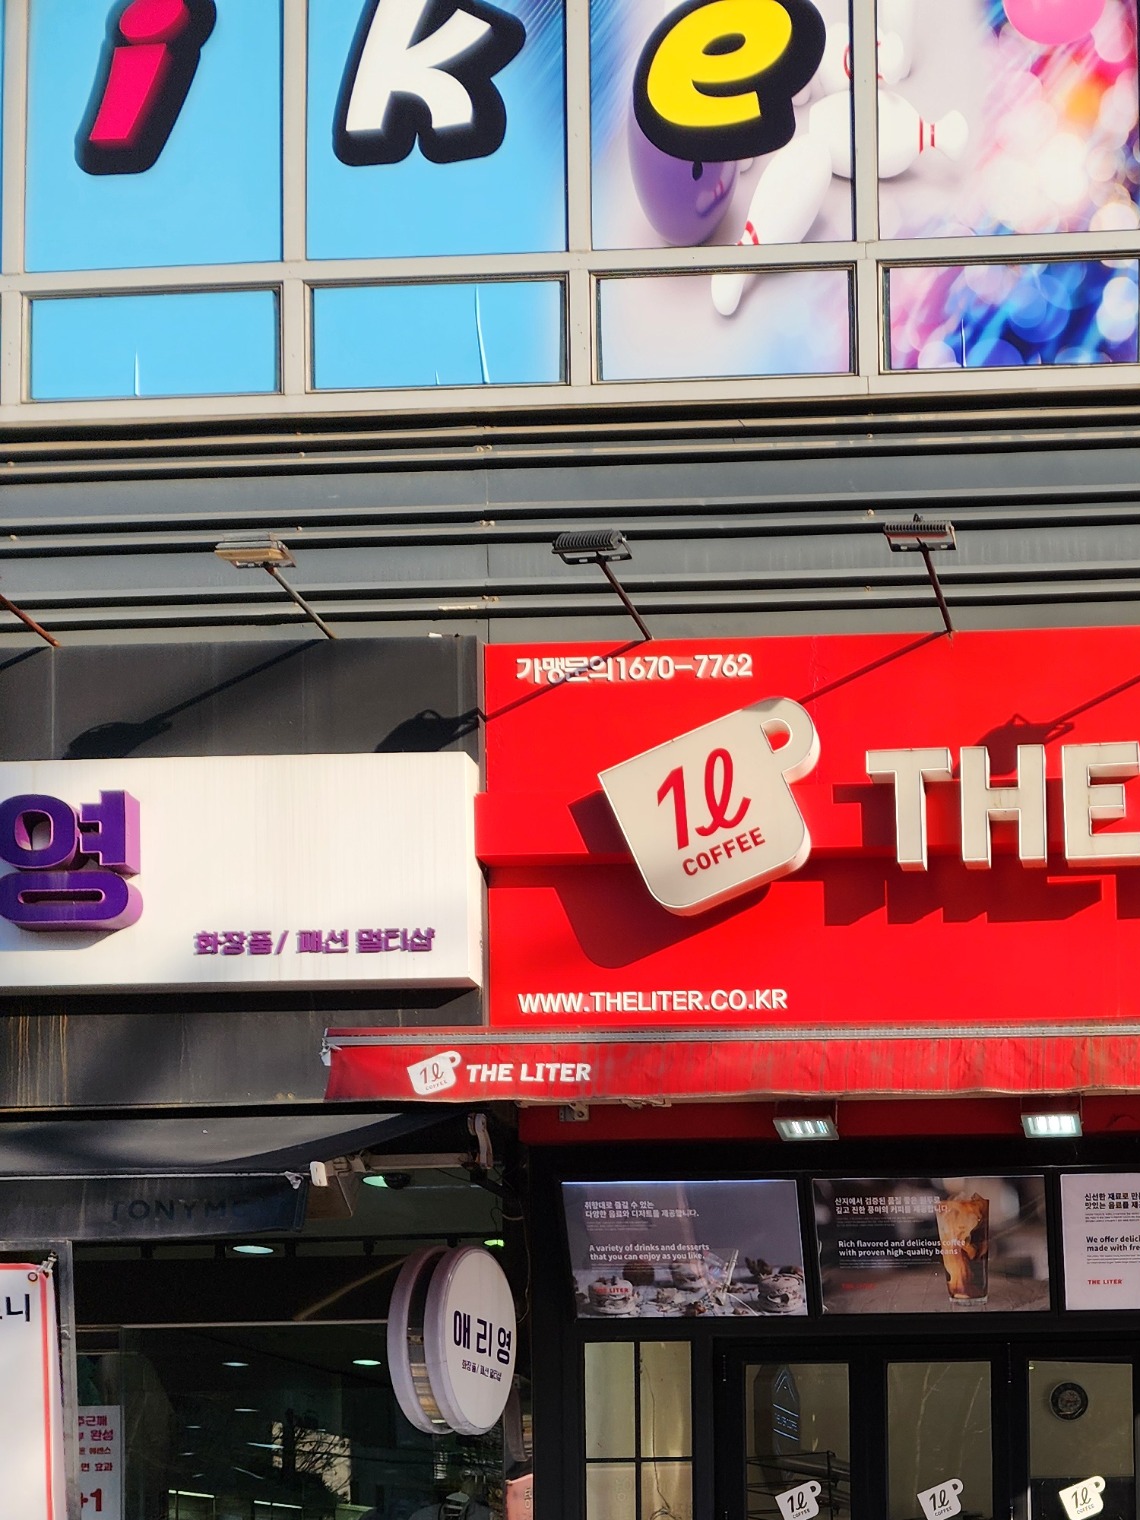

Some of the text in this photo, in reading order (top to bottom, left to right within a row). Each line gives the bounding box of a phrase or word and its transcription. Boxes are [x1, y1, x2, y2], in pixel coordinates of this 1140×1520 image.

[682, 827, 766, 876] COFFEE
[296, 930, 349, 954] 패션
[518, 988, 788, 1014] WWW.THELITER.CO.KR
[467, 1063, 591, 1083] THE LITER
[1084, 1192, 1106, 1201] 신선한
[838, 1238, 966, 1248] Rich flavored and delicious coffee
[1086, 1235, 1099, 1243] We
[1100, 1235, 1118, 1243] offer
[595, 1244, 623, 1252] variety
[839, 1247, 958, 1257] with proven high-quality beans
[1110, 1243, 1128, 1251] with
[608, 1254, 623, 1262] you
[639, 1252, 661, 1261] enjoy
